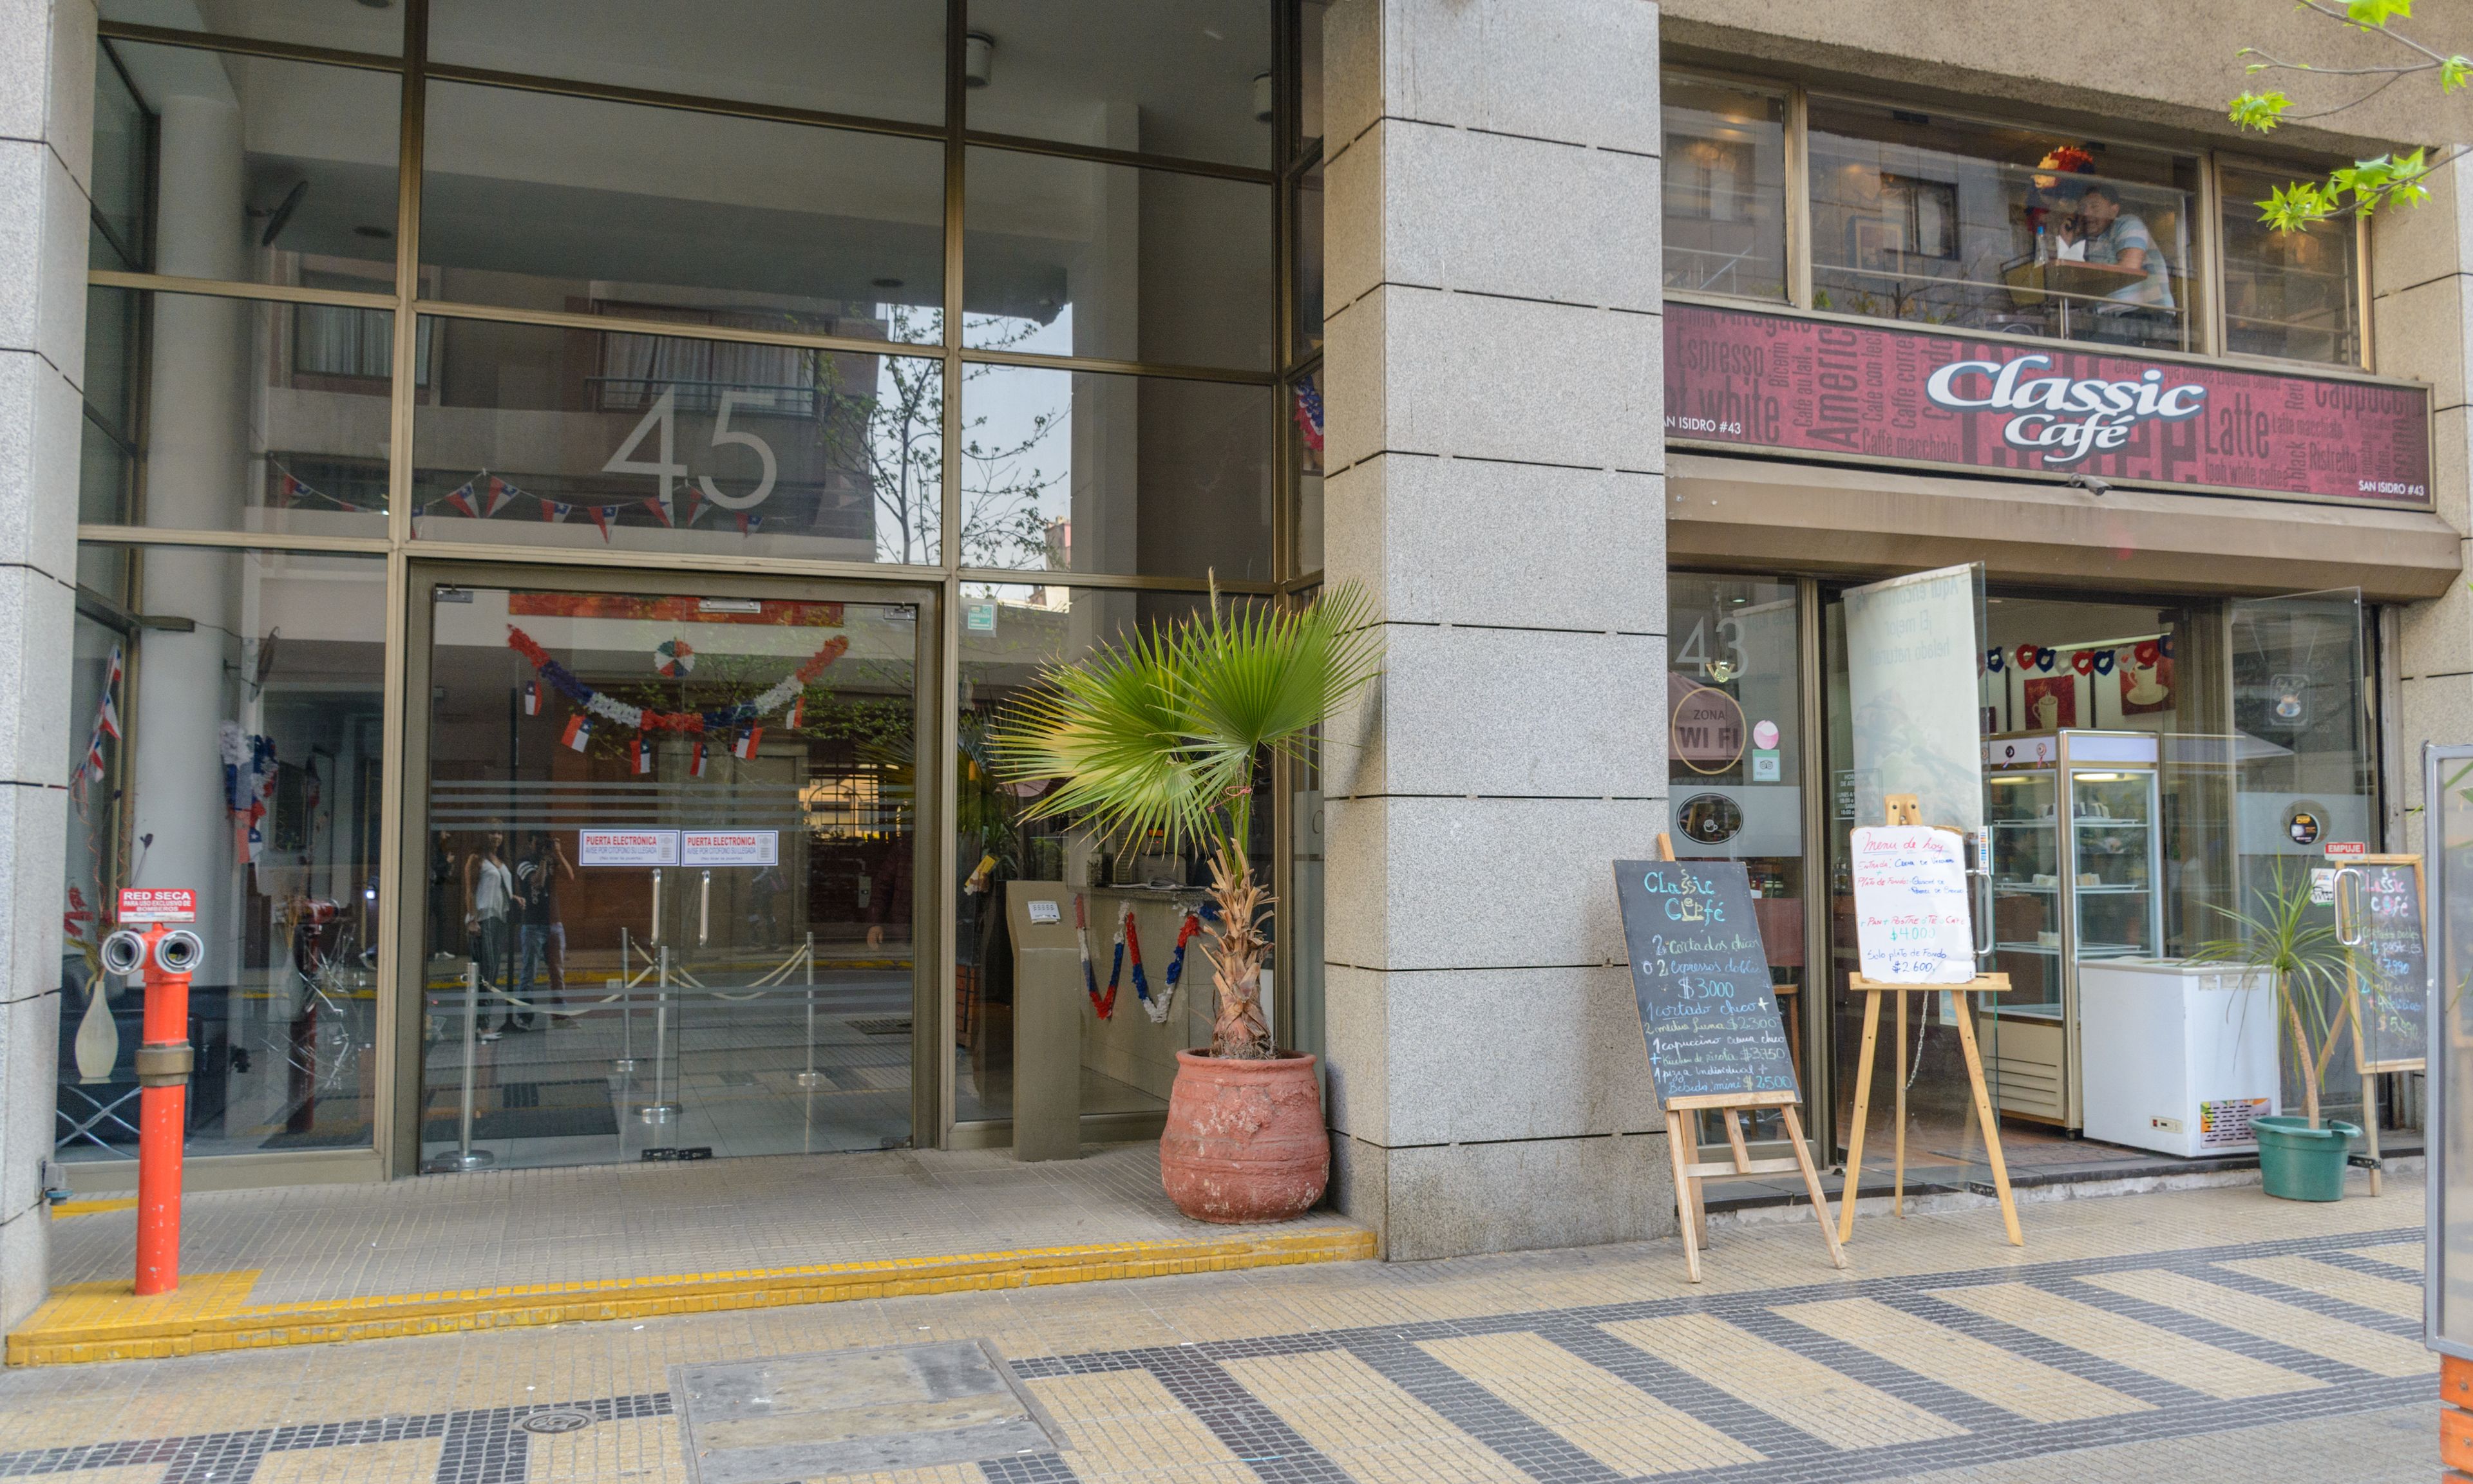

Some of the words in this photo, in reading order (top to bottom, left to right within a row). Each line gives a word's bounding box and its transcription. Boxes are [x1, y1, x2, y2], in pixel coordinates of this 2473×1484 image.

[1676, 325, 1763, 377] Espresso
[1768, 342, 1789, 387] Bicerin
[1866, 361, 1883, 387] con
[1927, 355, 2205, 417] Classic
[1679, 417, 1716, 432] ISIDRO
[1720, 422, 1741, 435] #43
[2204, 389, 2269, 459] Latte
[1897, 434, 1959, 462] macchiato
[2004, 412, 2135, 463] Café
[602, 384, 777, 529] 45
[2309, 441, 2357, 474] Ristretto
[2359, 480, 2376, 491] SAN
[2378, 481, 2405, 494] ISIDRO
[2408, 484, 2425, 496] #43
[1675, 616, 1749, 680] 43
[1693, 709, 1726, 720] ZONA
[1680, 727, 1709, 749] WI
[1718, 727, 1739, 749] FI
[586, 836, 611, 845] PUERTA
[613, 834, 656, 845] ELECTRÓNICA
[687, 837, 711, 846] PUERTA
[713, 835, 756, 846] ELECTRÓNICA
[1903, 837, 1916, 849] de
[1922, 837, 1944, 857] hoy
[2327, 844, 2362, 854] EMPUJE
[124, 892, 151, 900] RED
[155, 892, 191, 900] SECA
